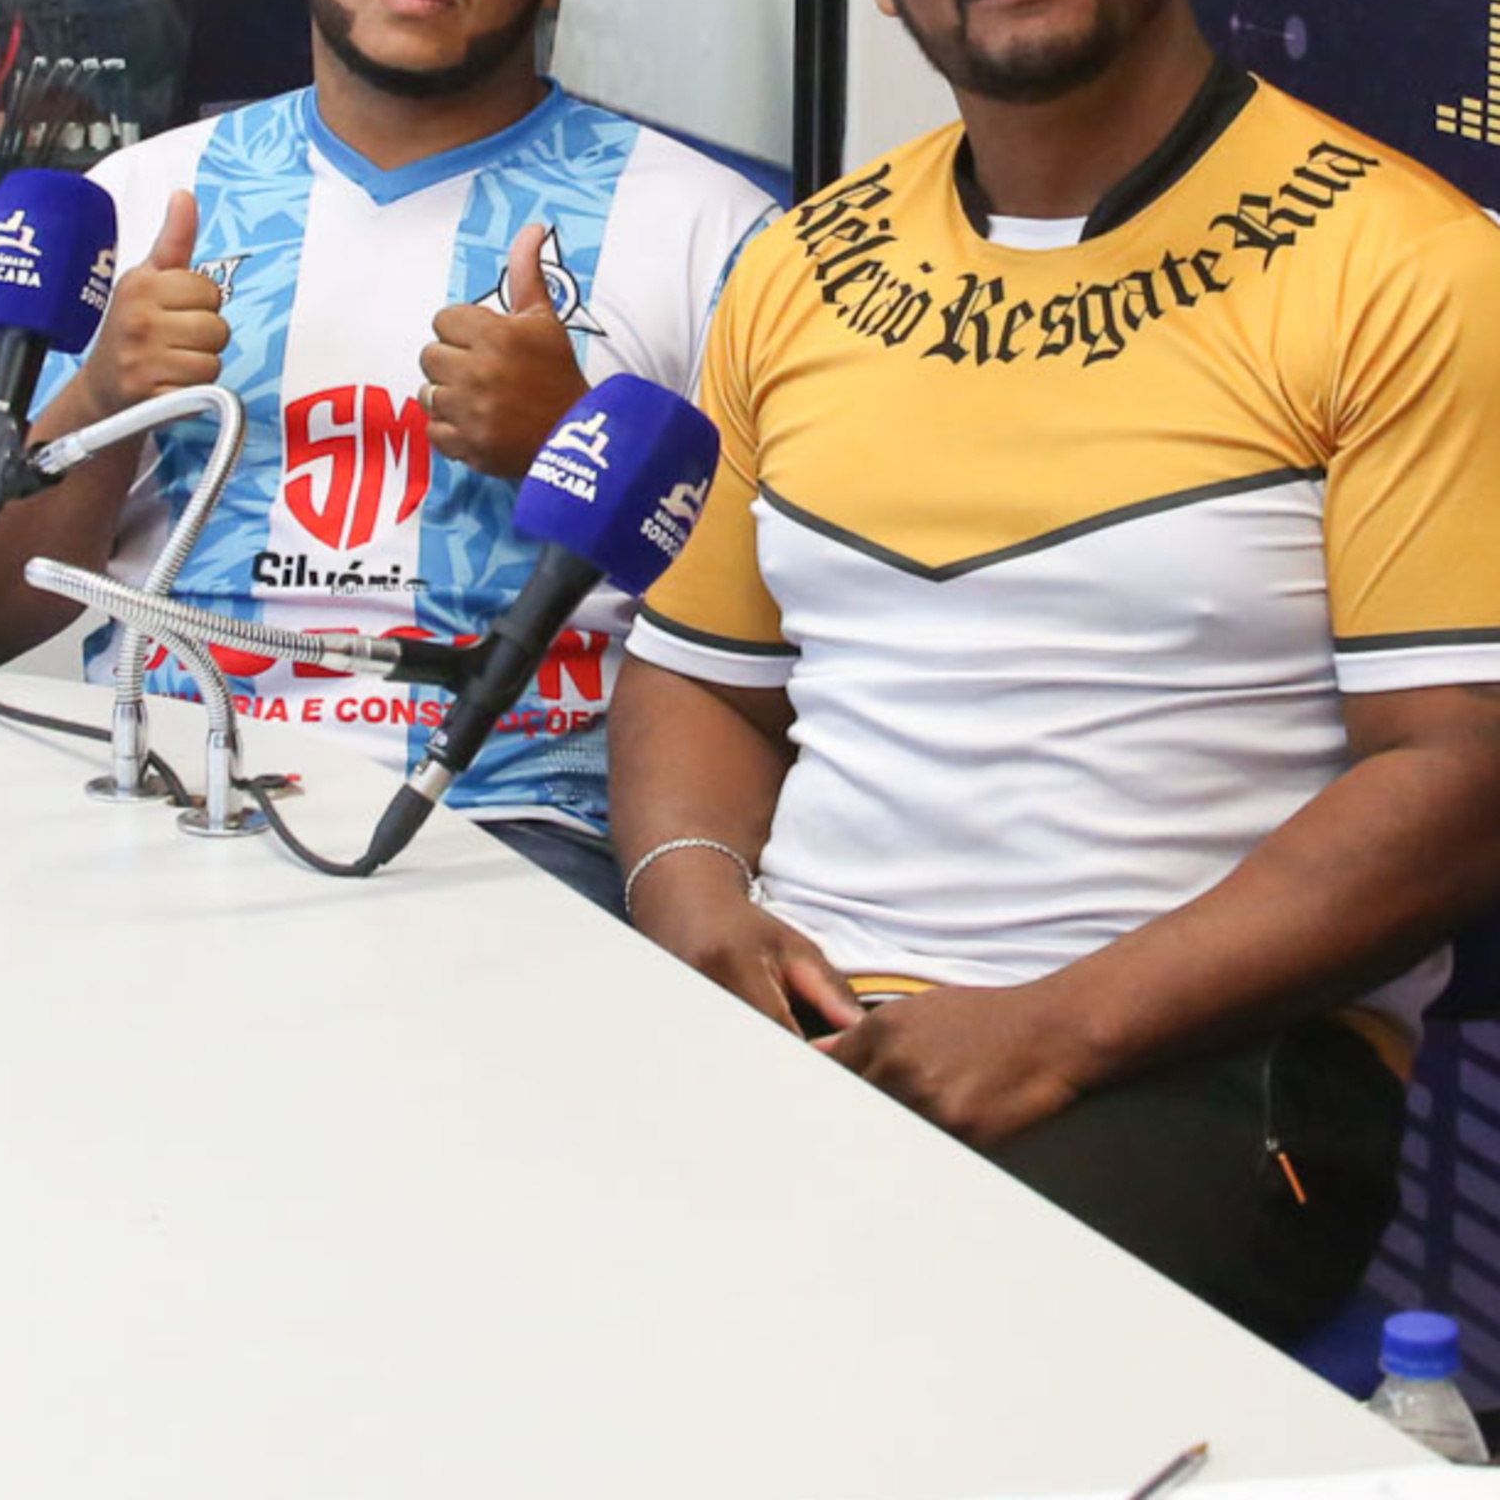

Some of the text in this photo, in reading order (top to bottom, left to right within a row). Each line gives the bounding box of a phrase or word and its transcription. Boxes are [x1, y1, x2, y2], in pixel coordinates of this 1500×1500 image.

[920, 248, 1233, 367] Resgate
[1209, 140, 1380, 271] Rua
[284, 384, 432, 551] SM
[252, 551, 432, 588] Silvéri
[302, 699, 324, 722] E
